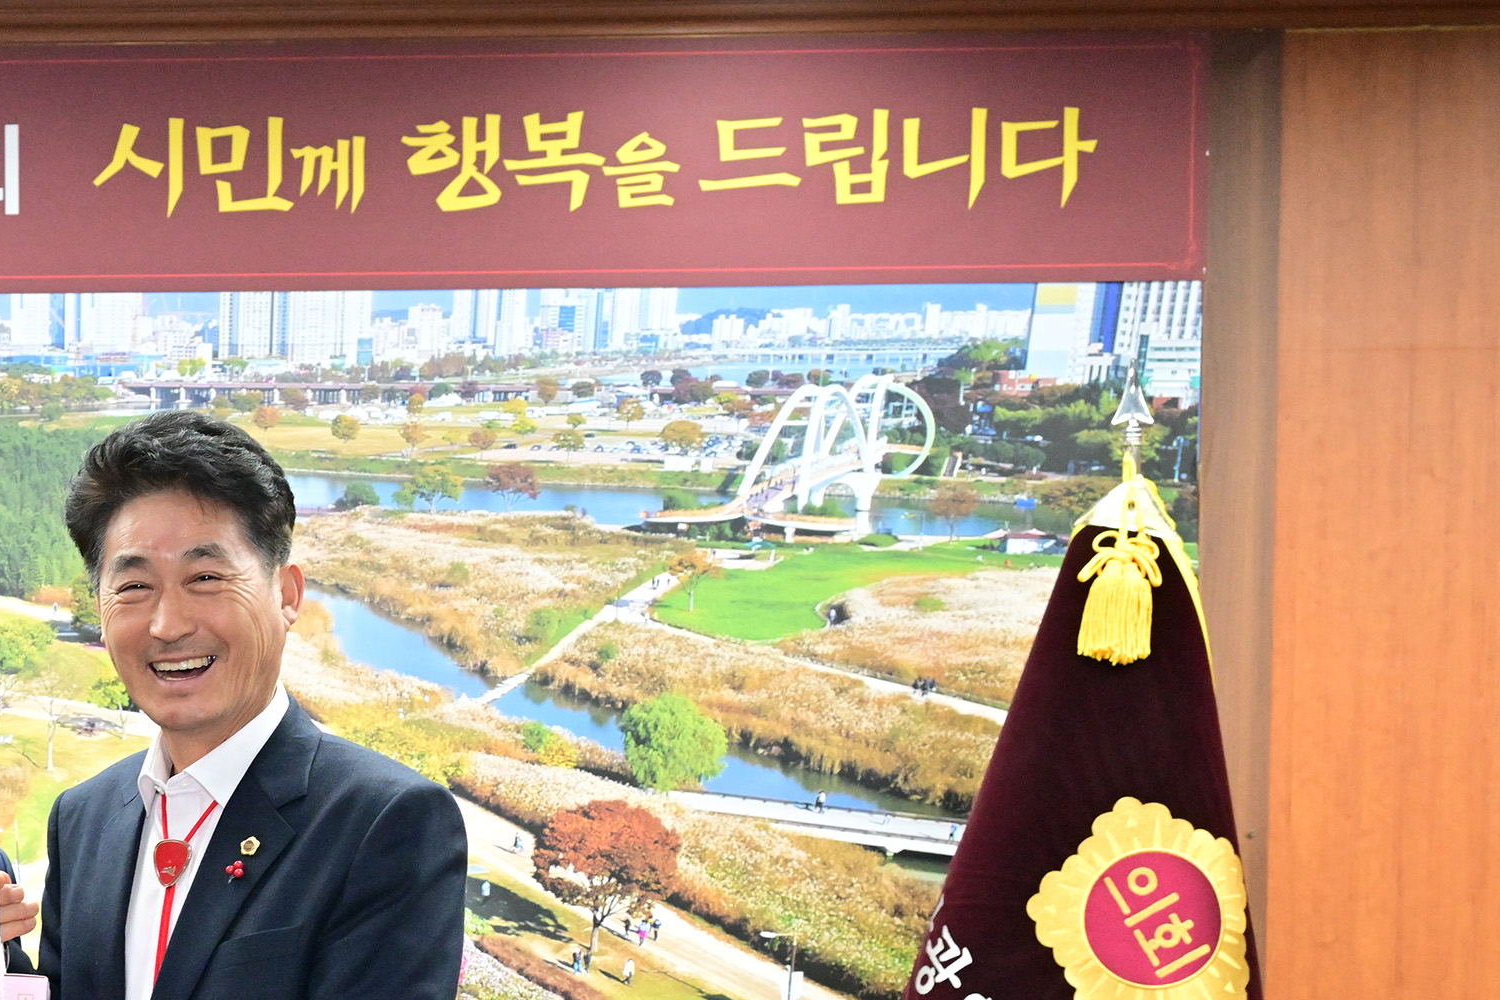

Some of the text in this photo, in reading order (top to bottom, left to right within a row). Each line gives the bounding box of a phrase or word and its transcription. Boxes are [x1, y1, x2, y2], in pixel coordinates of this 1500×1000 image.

[93, 116, 366, 218] 시민께
[400, 110, 682, 212] 행복을
[698, 106, 1098, 210] 드립니다
[1104, 867, 1210, 978] 의회
